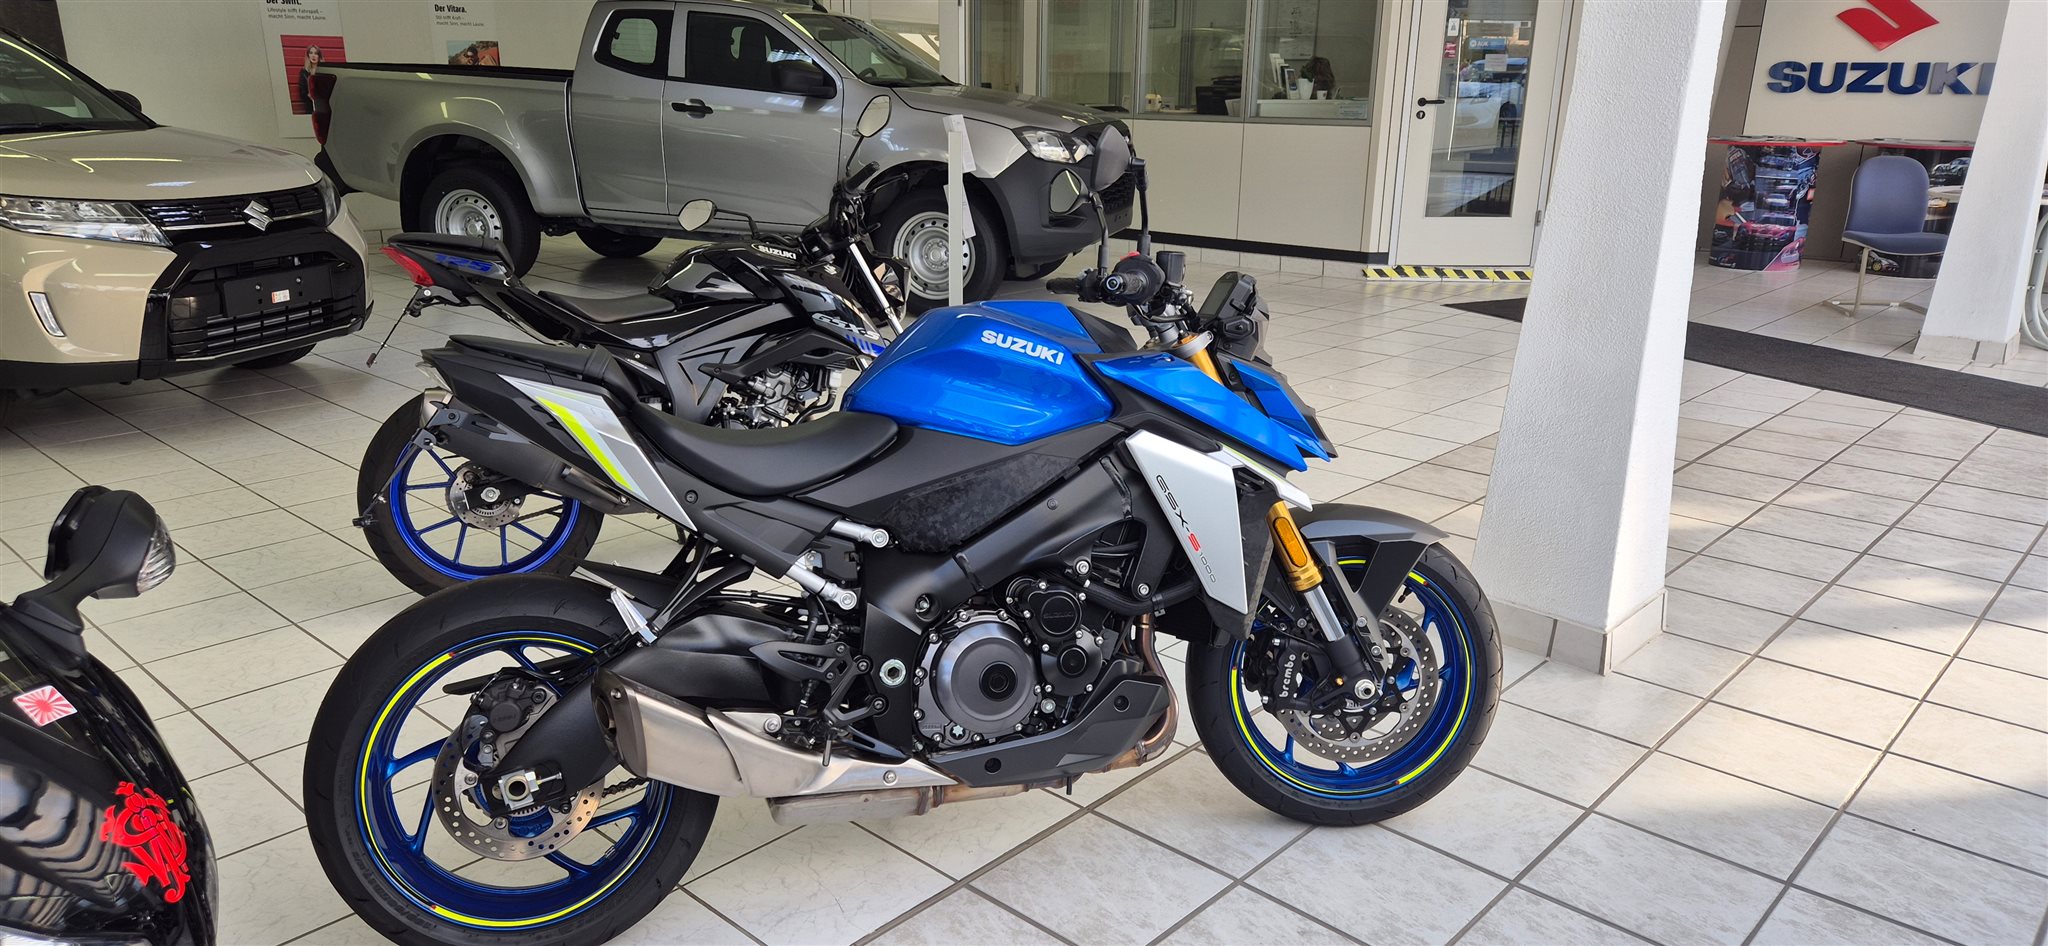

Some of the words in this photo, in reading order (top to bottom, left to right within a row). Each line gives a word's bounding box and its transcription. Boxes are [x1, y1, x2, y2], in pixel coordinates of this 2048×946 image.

[434, 4, 445, 12] Der
[446, 4, 467, 13] Vitara.
[1766, 61, 1996, 95] SUZUKI
[759, 245, 797, 260] SUZUKI
[980, 329, 1064, 366] SUZUKI
[1279, 654, 1296, 697] brembo
